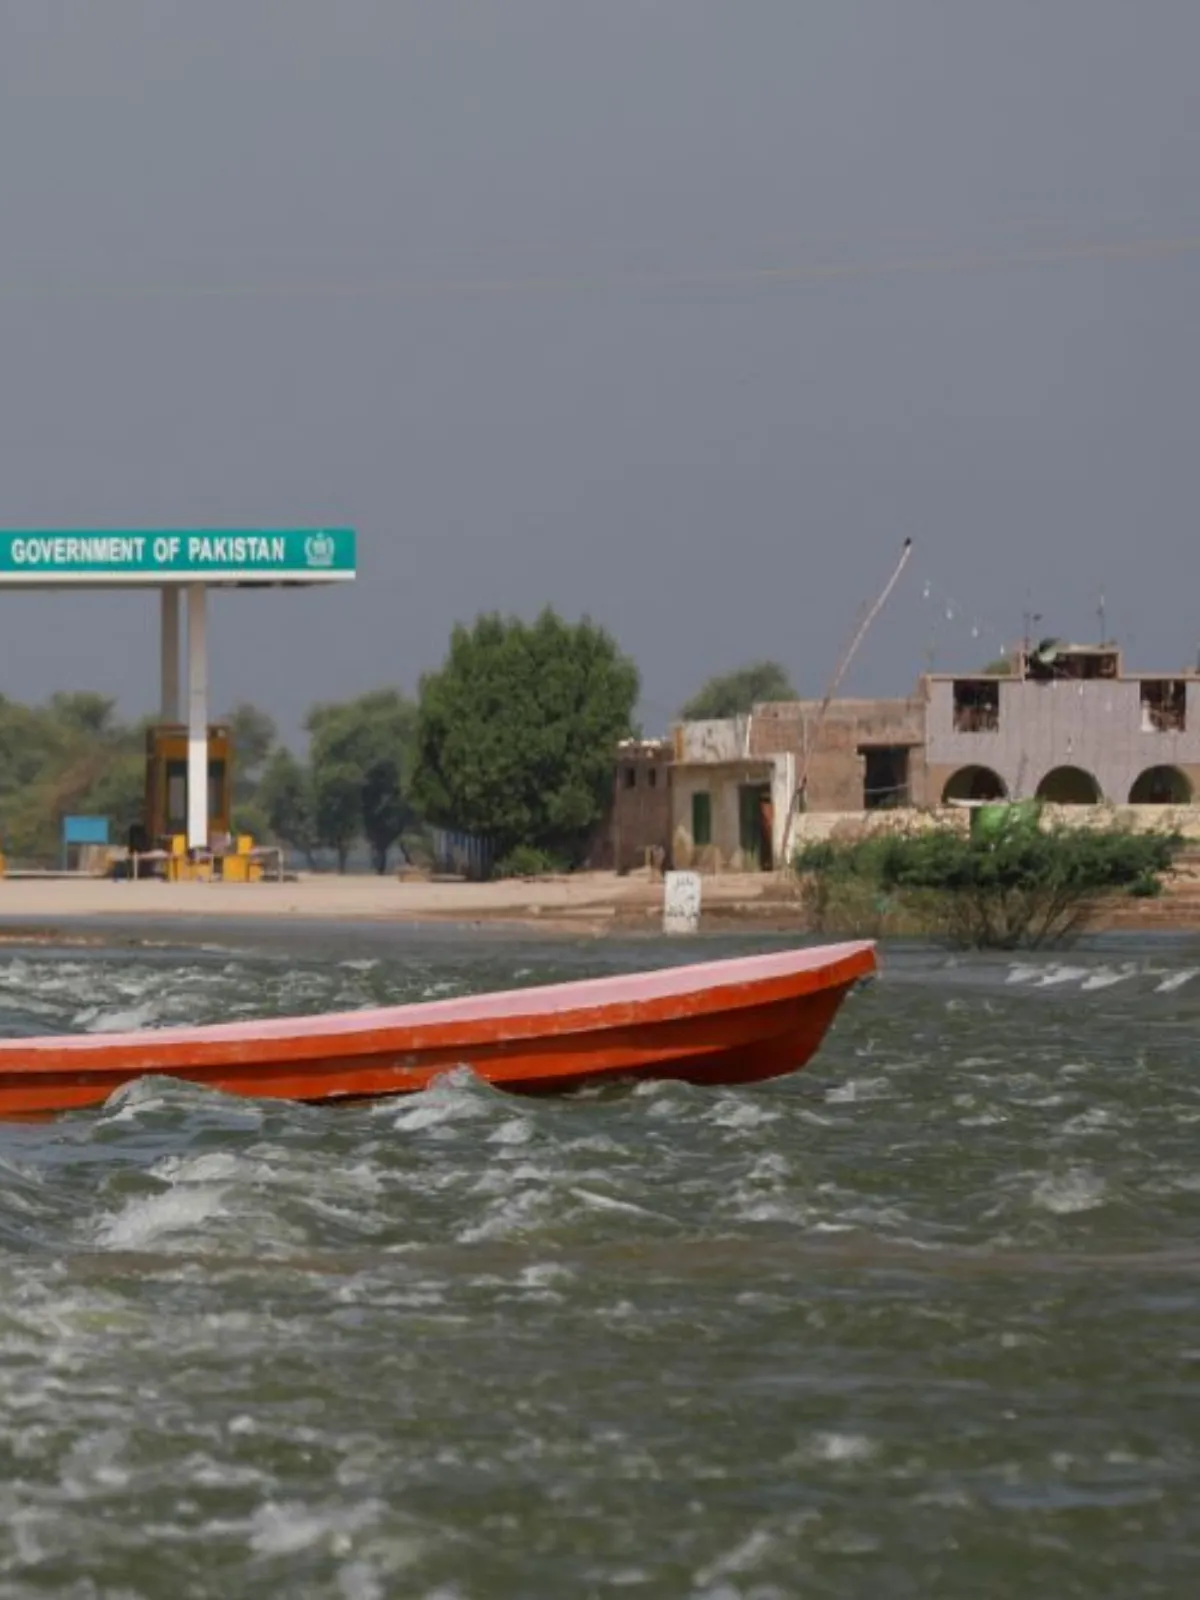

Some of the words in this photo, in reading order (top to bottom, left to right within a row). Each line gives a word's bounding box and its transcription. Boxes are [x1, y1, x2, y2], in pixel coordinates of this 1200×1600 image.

[11, 538, 146, 563] GOVERNMENT
[153, 537, 180, 562] OF
[189, 537, 285, 562] PAKISTAN
